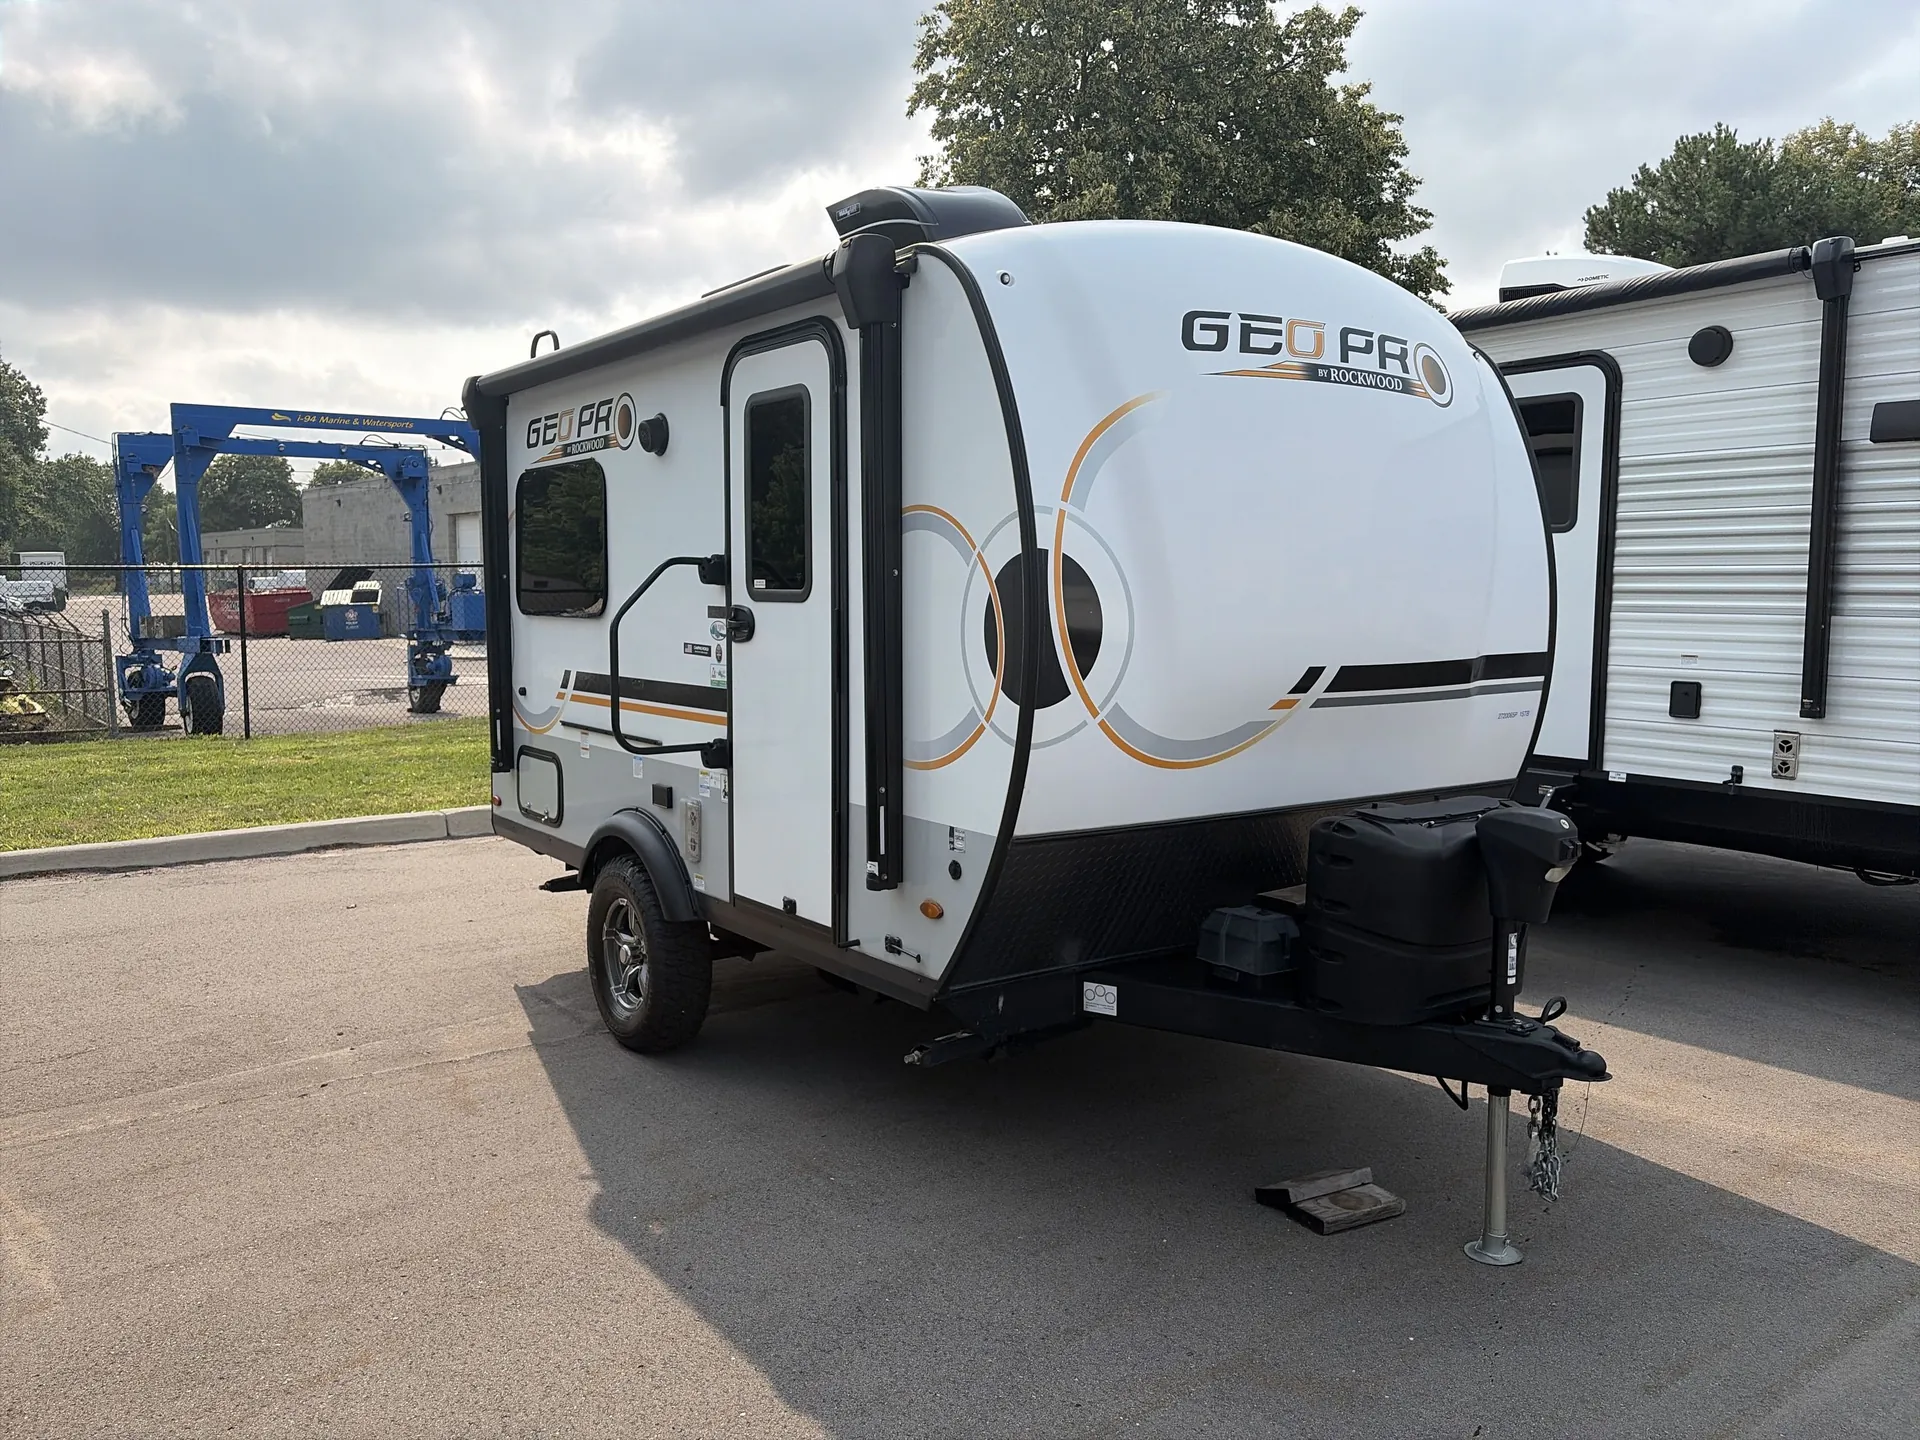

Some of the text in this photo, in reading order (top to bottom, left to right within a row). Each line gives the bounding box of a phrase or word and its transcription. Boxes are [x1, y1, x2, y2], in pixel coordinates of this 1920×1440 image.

[1584, 273, 1610, 282] DOMETIC
[1181, 310, 1454, 409] GEO PRO
[1317, 368, 1403, 391] BY ROCKWOOD
[297, 414, 414, 430] i-94 Marine & Watersports
[526, 392, 637, 451] GEO PRO
[571, 438, 605, 455] ROCKWOOD
